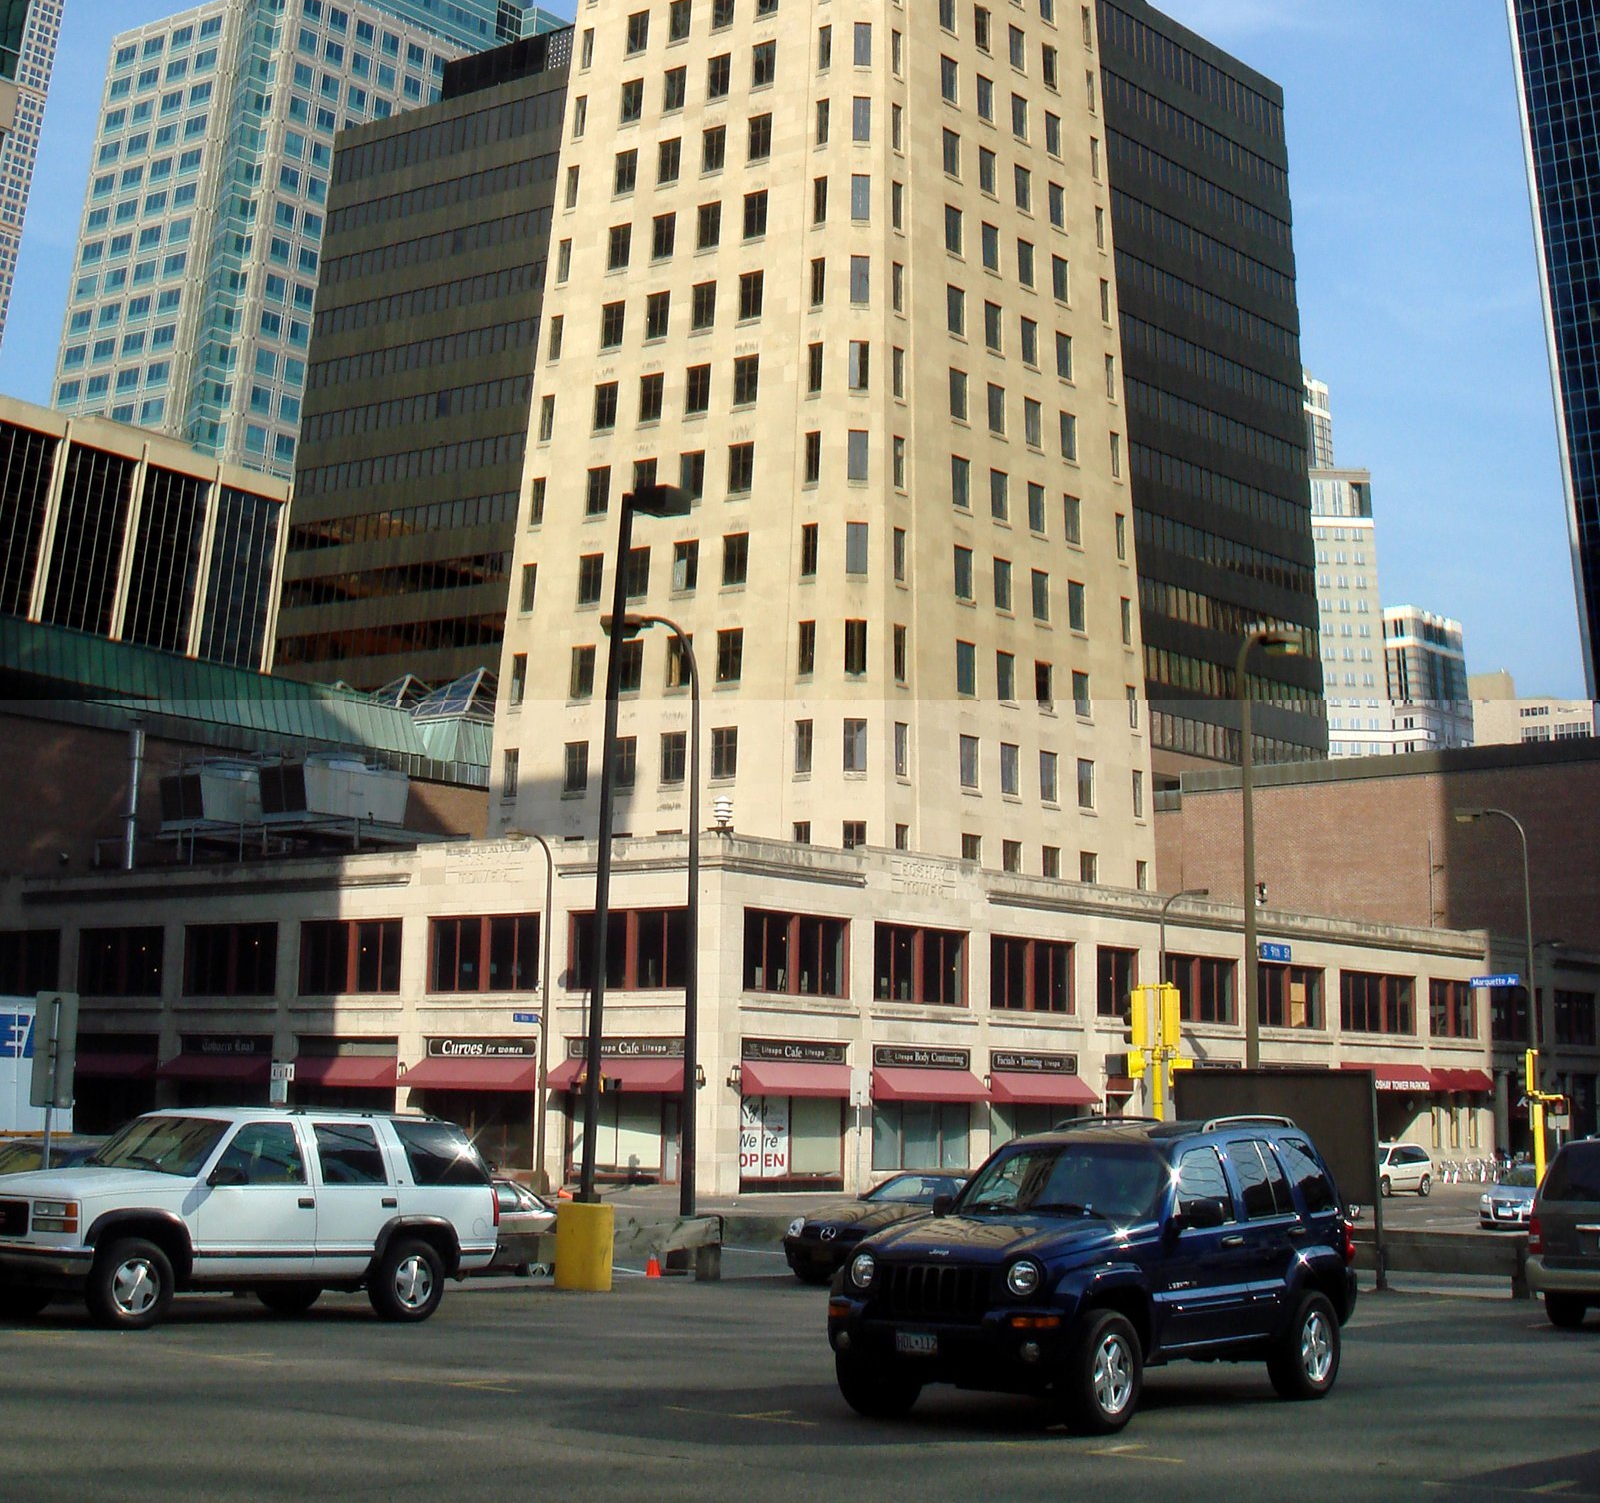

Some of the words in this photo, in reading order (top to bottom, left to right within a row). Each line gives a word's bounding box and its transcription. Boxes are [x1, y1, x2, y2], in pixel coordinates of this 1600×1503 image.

[1262, 944, 1268, 956] S
[1270, 946, 1281, 957] 9th
[1283, 947, 1291, 958] St
[1472, 978, 1506, 987] Marquette
[1507, 976, 1517, 986] Av
[442, 1040, 483, 1055] Curves
[484, 1044, 496, 1055] for
[498, 1046, 523, 1054] women
[618, 1041, 640, 1054] Cafe
[784, 1045, 803, 1058] Cafe
[914, 1051, 930, 1065] Body
[931, 1052, 964, 1066] Contouring
[997, 1055, 1016, 1066] Facials
[1020, 1056, 1042, 1070] Tanning
[1375, 1079, 1392, 1090] OSHAY
[1392, 1080, 1409, 1091] TOWER
[1409, 1080, 1431, 1091] PARKING
[739, 1152, 785, 1168] OPEN
